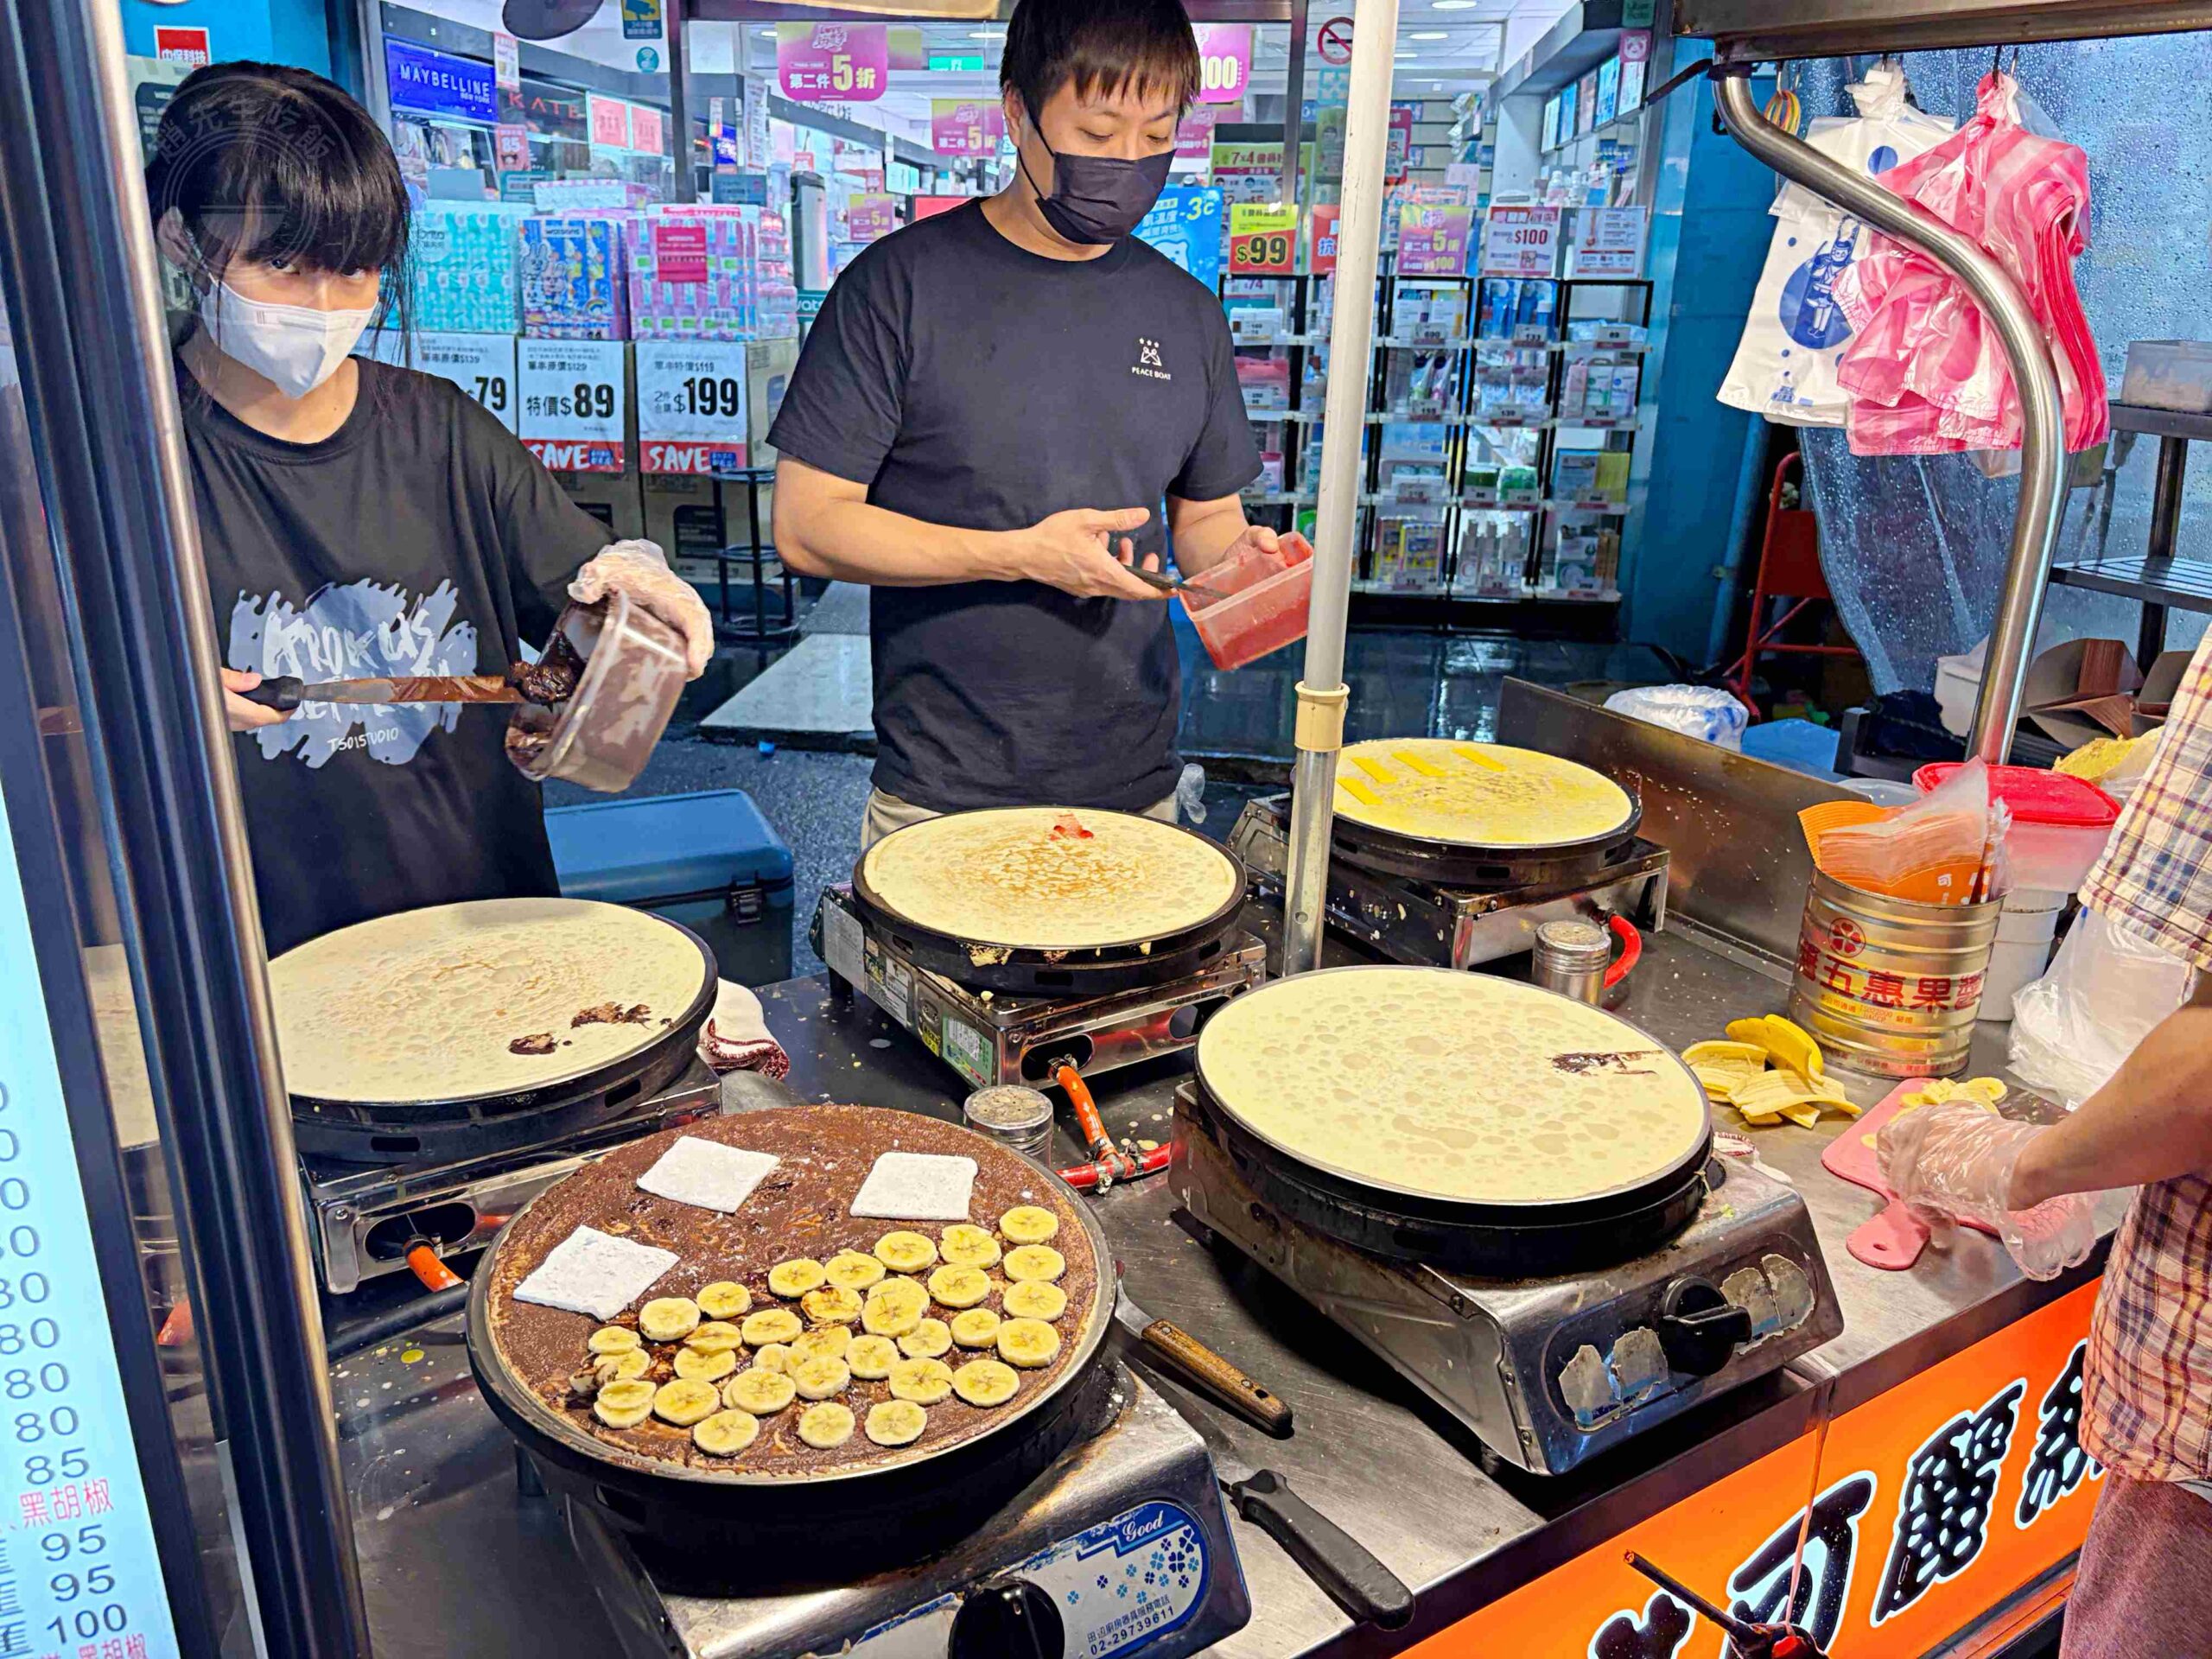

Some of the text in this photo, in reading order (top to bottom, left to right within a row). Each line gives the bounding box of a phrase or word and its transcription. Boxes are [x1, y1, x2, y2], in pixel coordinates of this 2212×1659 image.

[400, 63, 489, 97] MAYBELLINE
[508, 92, 580, 119] KATE
[1236, 236, 1287, 264] $99
[1514, 228, 1548, 245] $100
[1132, 366, 1172, 380] PEACE BOAT
[467, 376, 507, 411] 79
[526, 383, 614, 418] 特價$89
[673, 377, 739, 417] $199
[649, 444, 711, 474] SAVE
[0, 1317, 60, 1356] 80
[3, 1362, 71, 1400] 80
[14, 1406, 79, 1443] 80
[24, 1447, 90, 1485] 85
[41, 1523, 107, 1561] 95
[1122, 1510, 1164, 1542] Good
[50, 1564, 116, 1602] 95
[46, 1603, 128, 1645] 100
[1090, 1605, 1174, 1656] 02-29739611
